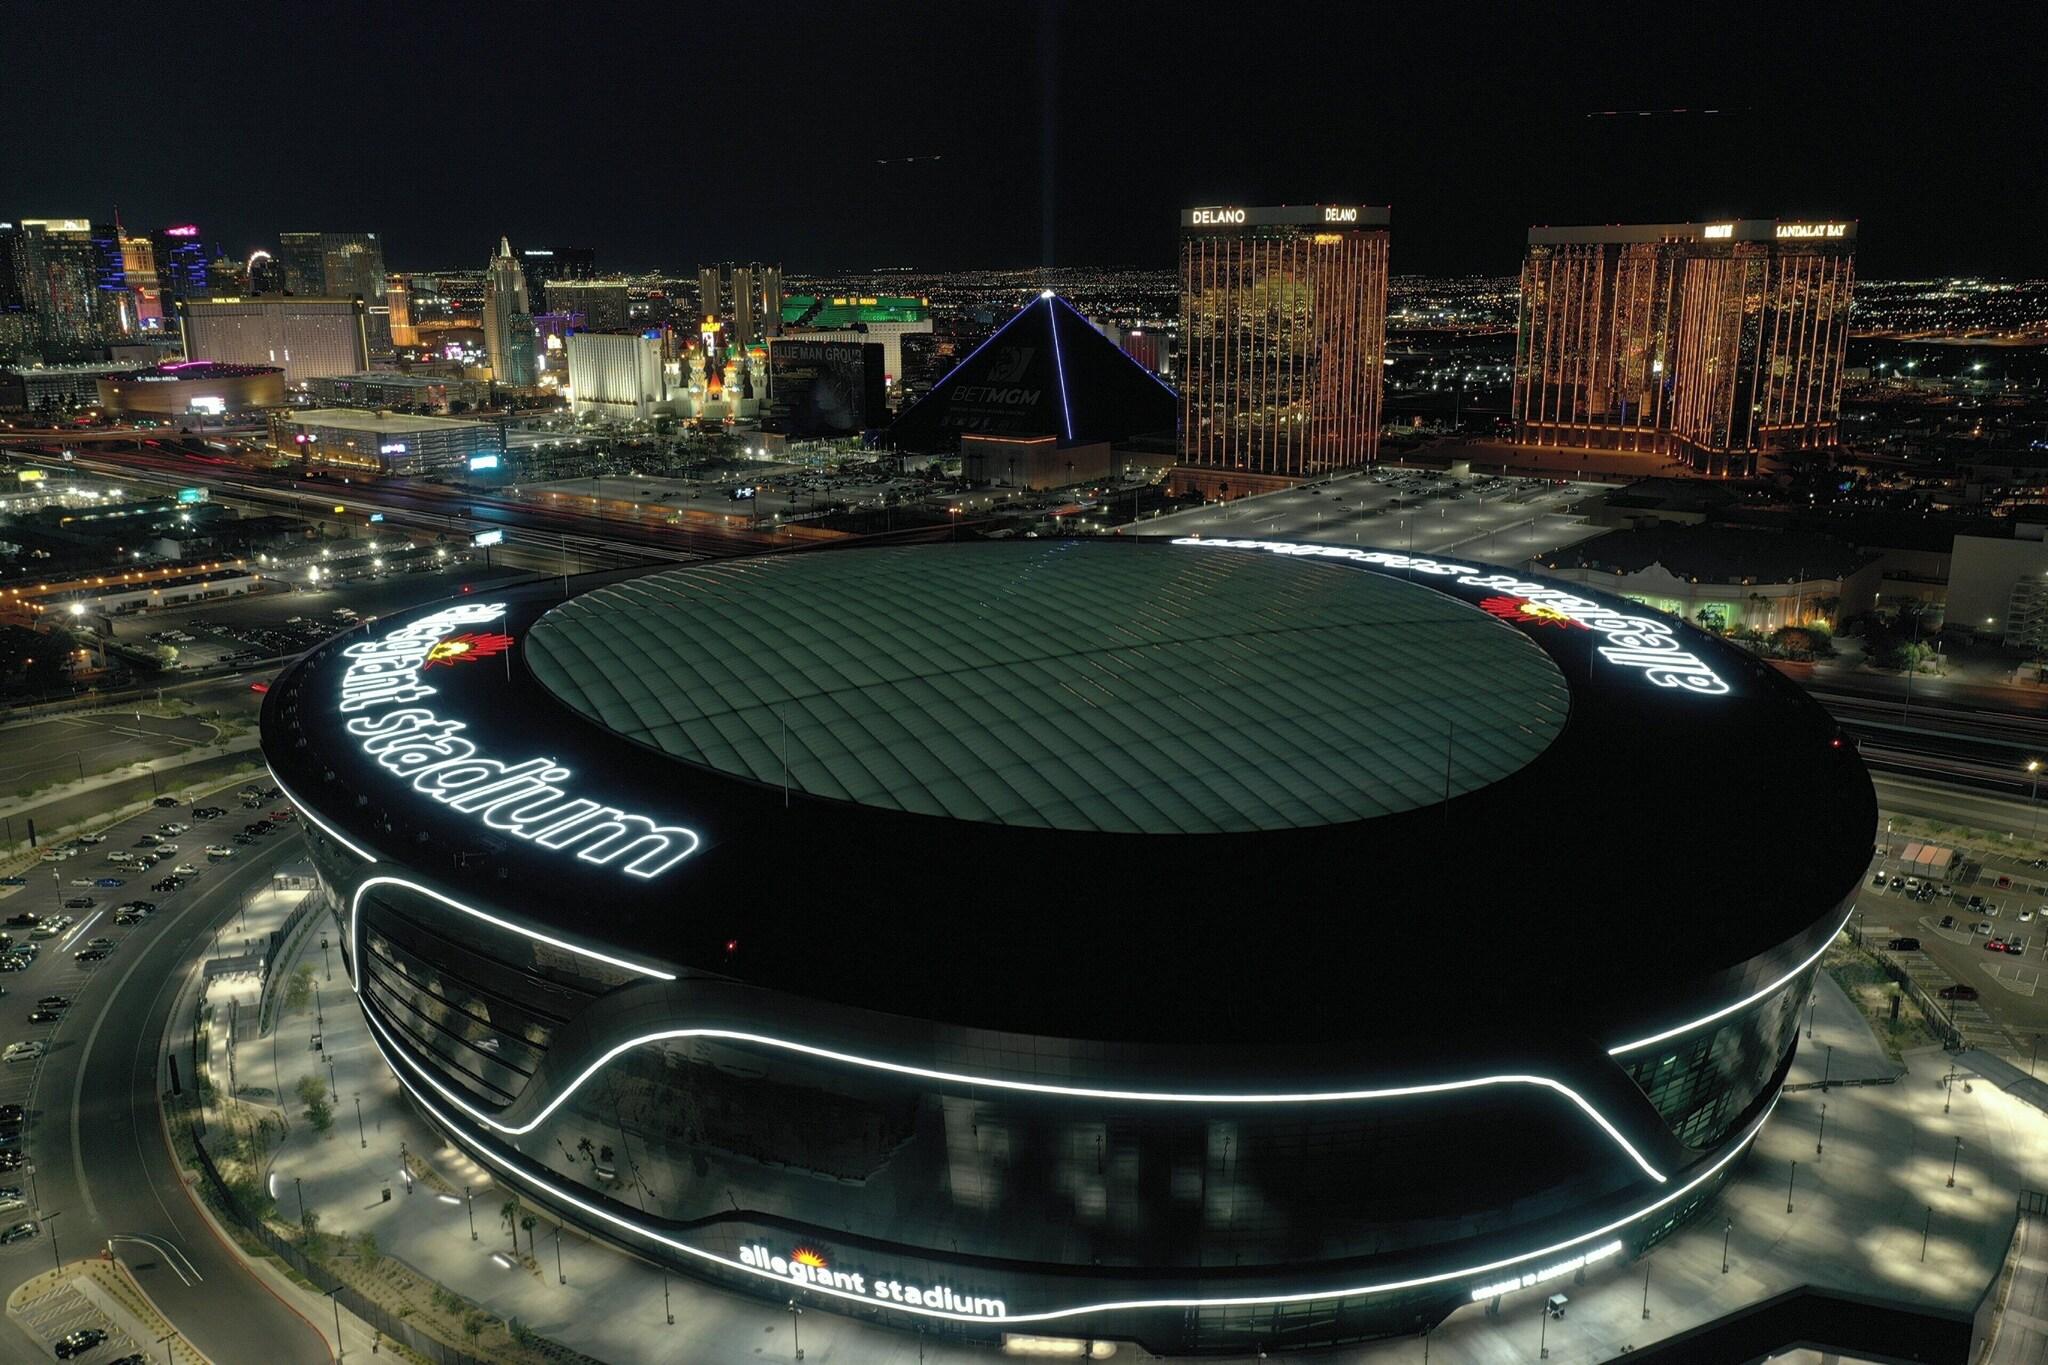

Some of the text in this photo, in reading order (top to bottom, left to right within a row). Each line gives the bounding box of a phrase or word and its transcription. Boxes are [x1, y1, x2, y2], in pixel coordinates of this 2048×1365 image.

[1192, 209, 1246, 224] DELANO
[1325, 208, 1357, 222] DELANO
[1827, 224, 1847, 237] BAY
[772, 344, 863, 364] BLUE MAN GROUP
[951, 384, 1042, 406] BETMGM
[339, 603, 700, 879] allegiant stadium
[738, 1245, 1007, 1318] allegiant stadium
